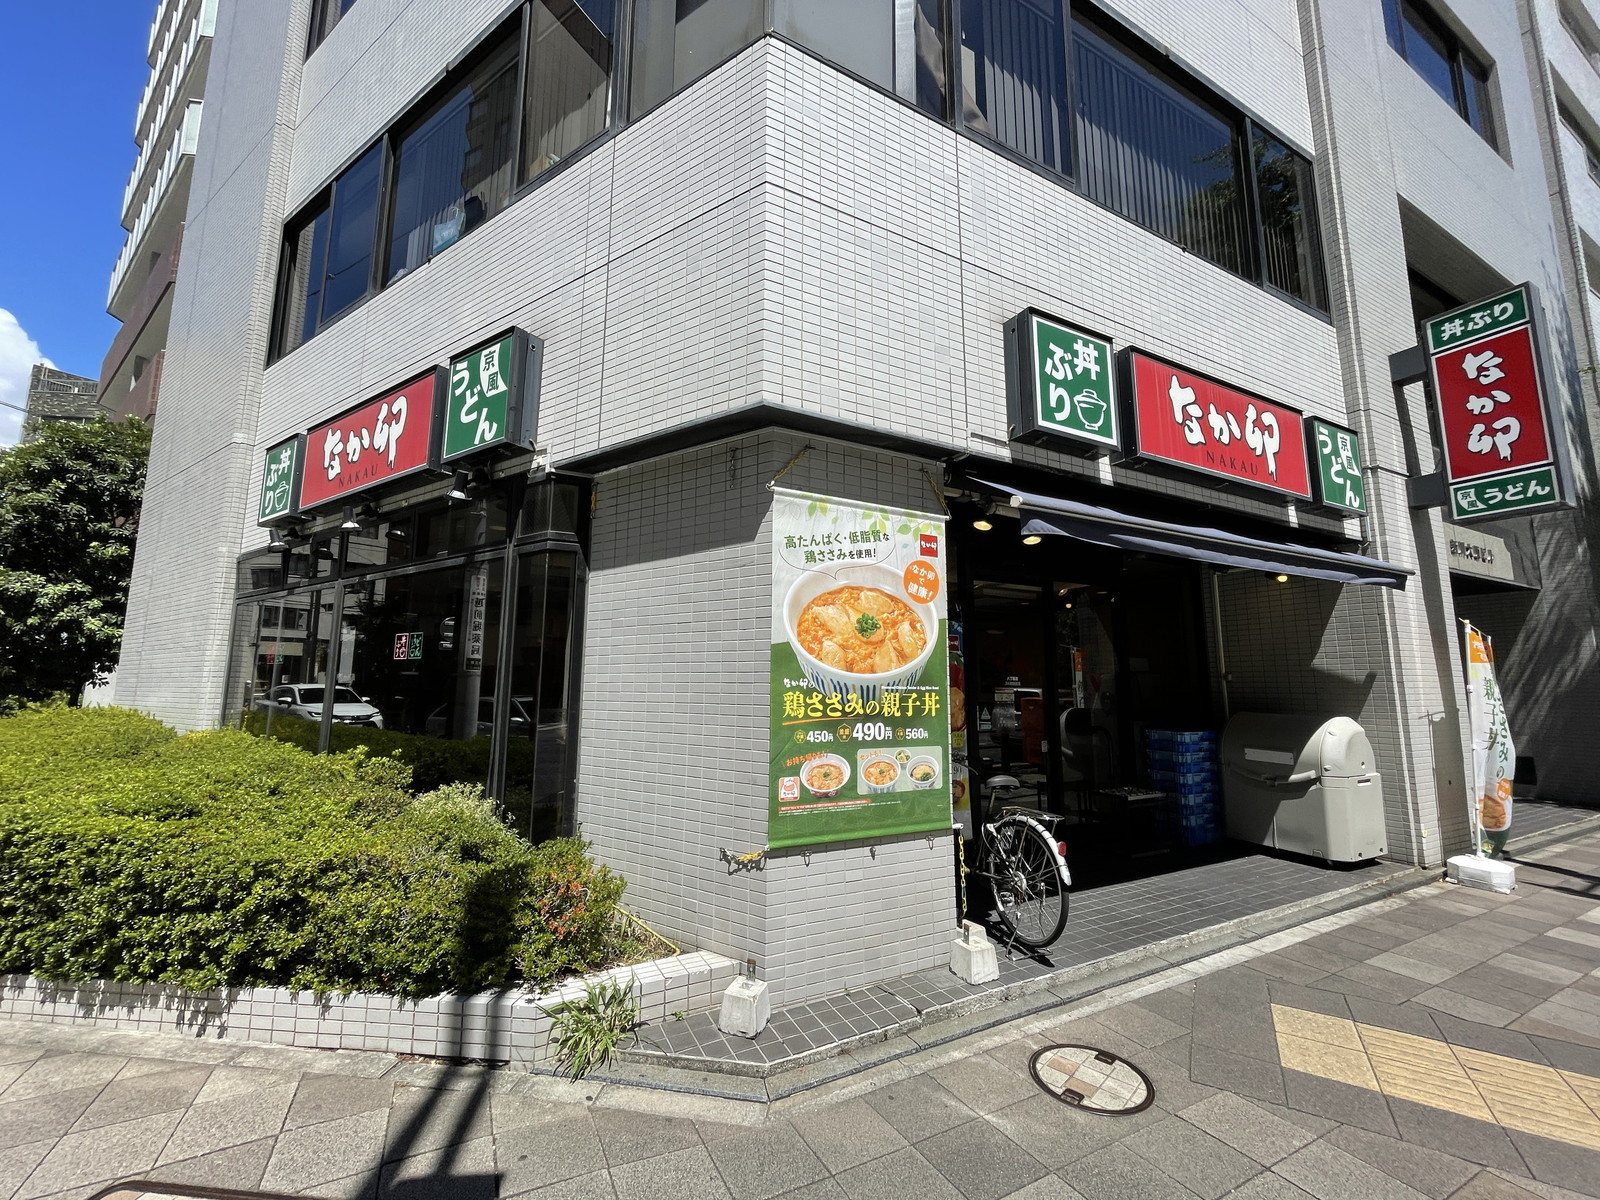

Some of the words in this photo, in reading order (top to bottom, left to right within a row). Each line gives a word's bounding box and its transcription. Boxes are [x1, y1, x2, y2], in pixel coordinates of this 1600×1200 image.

[1441, 301, 1514, 341] 丼ぶり
[483, 351, 499, 395] 京風
[1044, 339, 1100, 422] 丼ぶり
[452, 361, 498, 445] うどん
[1461, 350, 1521, 461] なか卯
[323, 395, 408, 482] なか卯
[1168, 374, 1280, 482] なか卯
[264, 447, 292, 513] 丼ぶり
[338, 464, 379, 488] NAKAU
[1206, 450, 1259, 475] NAKAU
[1318, 426, 1360, 508] うどん
[1461, 490, 1480, 509] 京風
[1483, 480, 1551, 504] うどん
[784, 530, 890, 550] 高たんぱく・低脂質な
[911, 564, 936, 581] なか卯
[782, 691, 940, 718] 鶏ささみの親子丼
